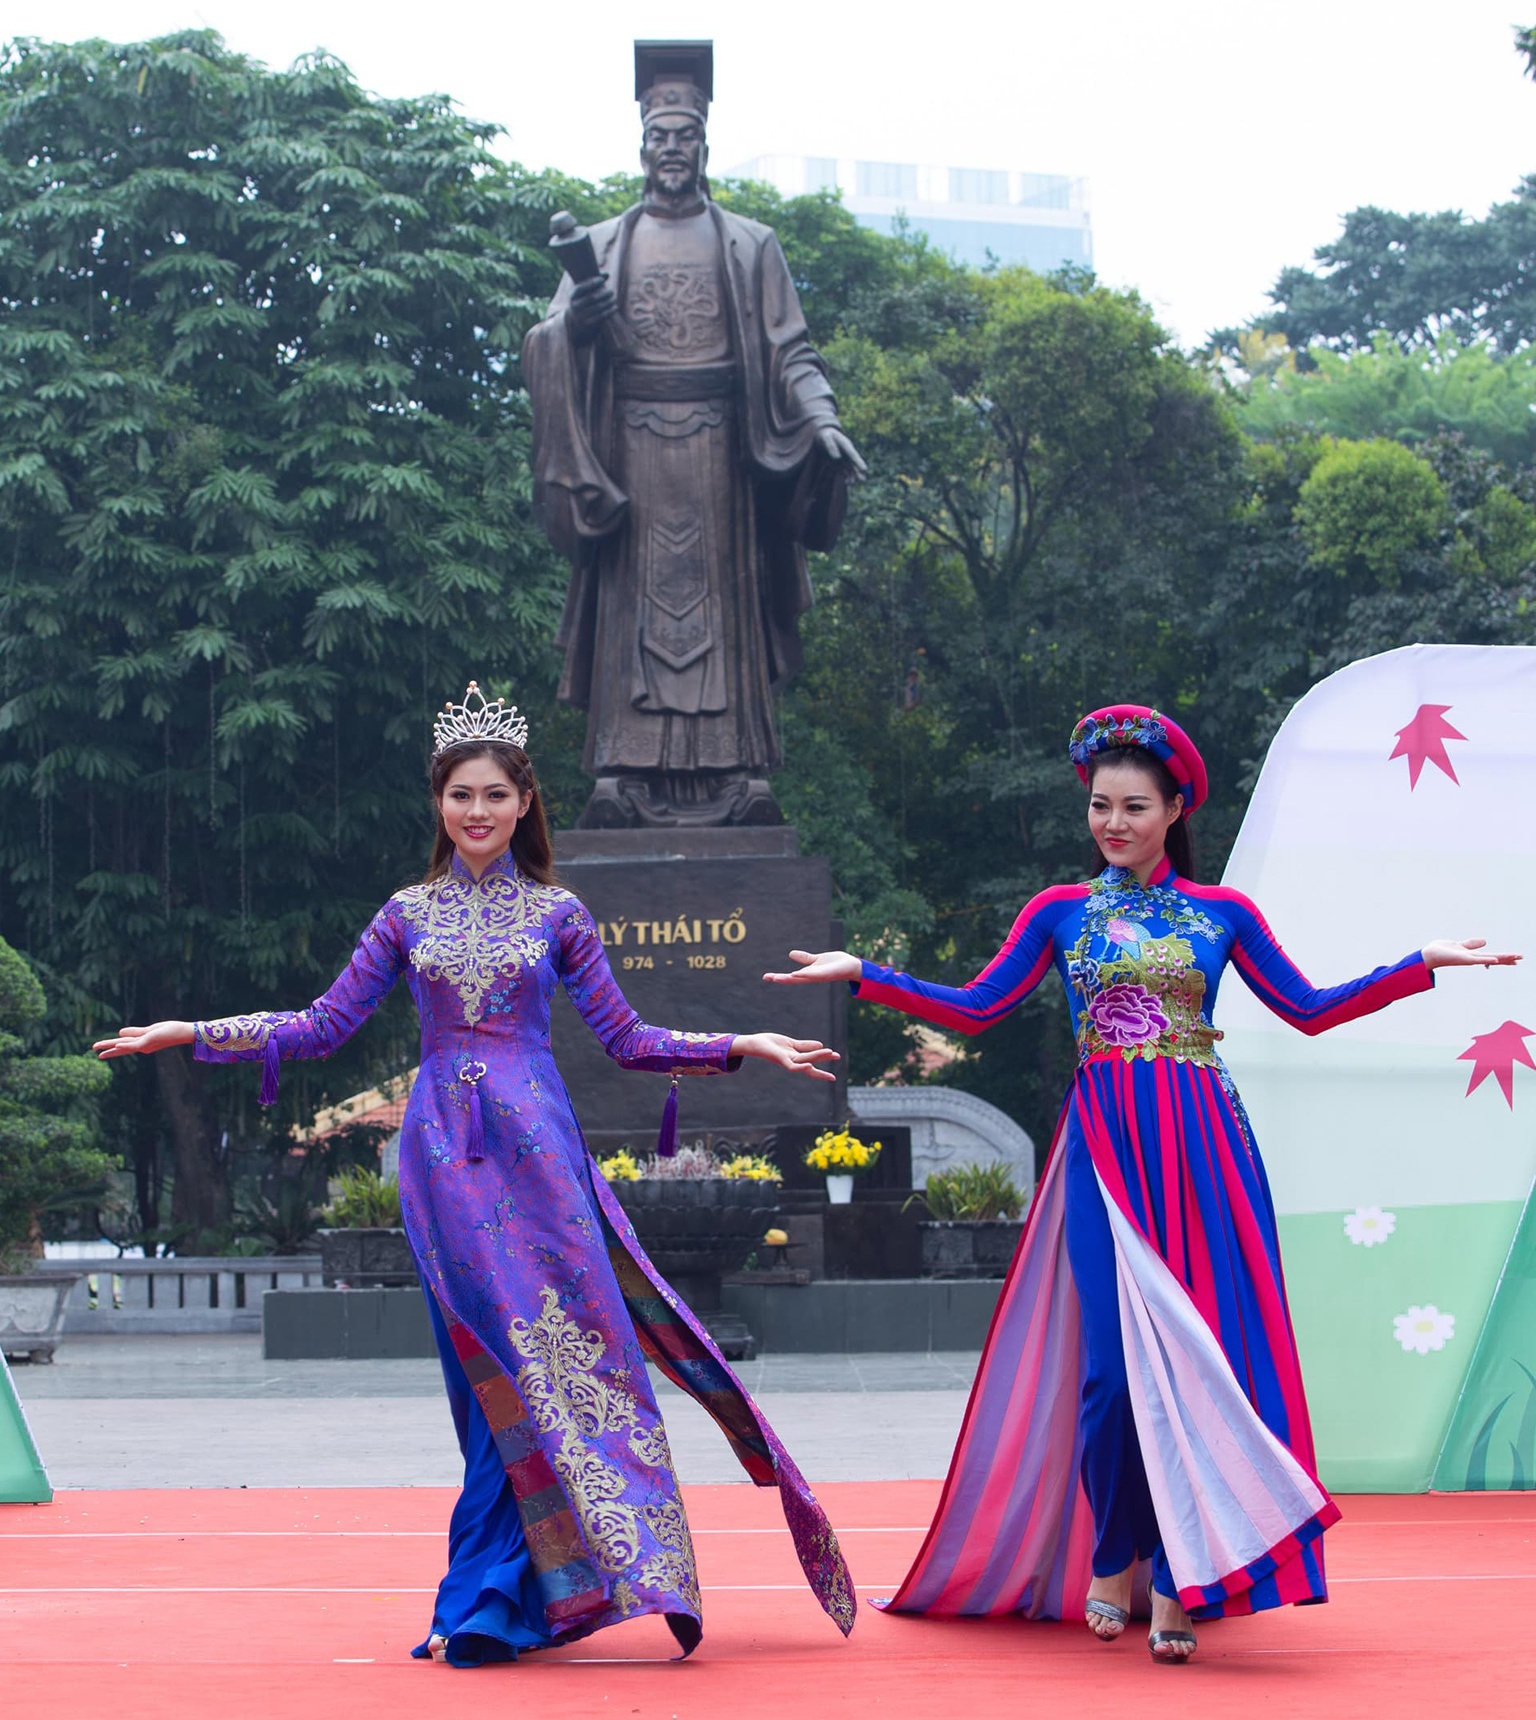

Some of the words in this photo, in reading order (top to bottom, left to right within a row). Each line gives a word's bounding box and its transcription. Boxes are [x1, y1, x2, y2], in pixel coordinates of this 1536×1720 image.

[598, 915, 628, 946] LÝ
[632, 913, 702, 945] THÁI
[706, 907, 747, 943] TỔ
[622, 956, 655, 970] 974
[687, 955, 727, 969] 1028
